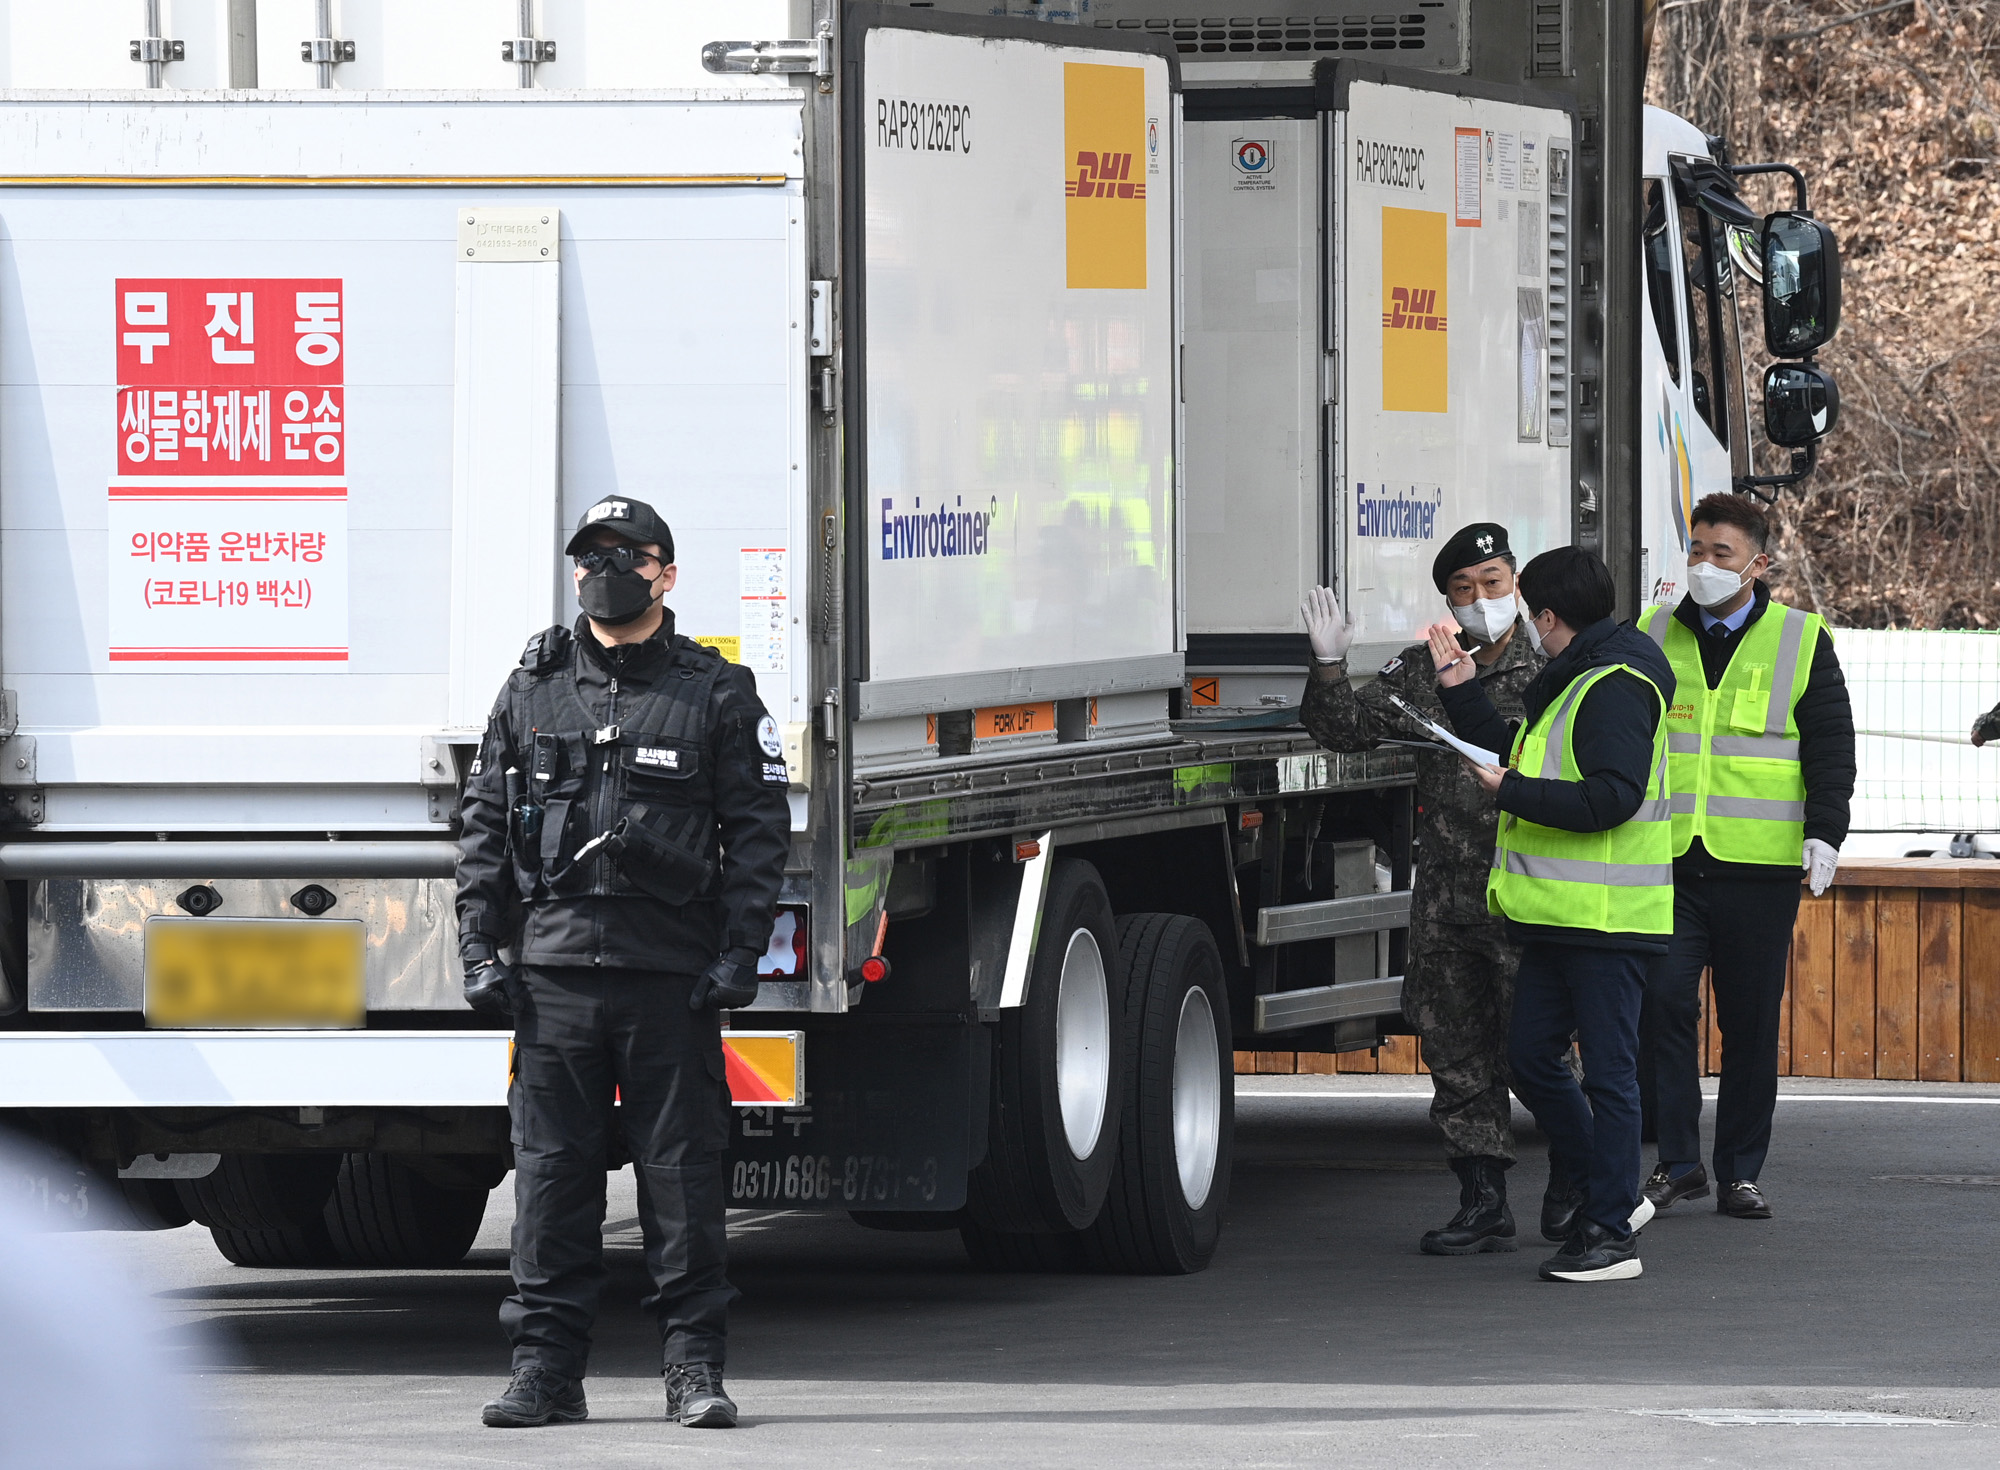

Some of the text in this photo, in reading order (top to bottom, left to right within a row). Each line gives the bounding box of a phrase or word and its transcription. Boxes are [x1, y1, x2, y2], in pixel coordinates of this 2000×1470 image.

[878, 98, 971, 154] RAP81262PC
[1076, 151, 1136, 199] DHL
[1356, 139, 1425, 191] RAP80529PC
[1390, 286, 1439, 331] DHL
[121, 389, 342, 463] 생물학제제 운송
[131, 531, 326, 563] 의약품 운반차량
[144, 578, 312, 609] (코로나19 백신)
[1660, 582, 1676, 597] FPT
[699, 637, 737, 645] MAX 1500kg
[993, 710, 1035, 734] FORK LIFT
